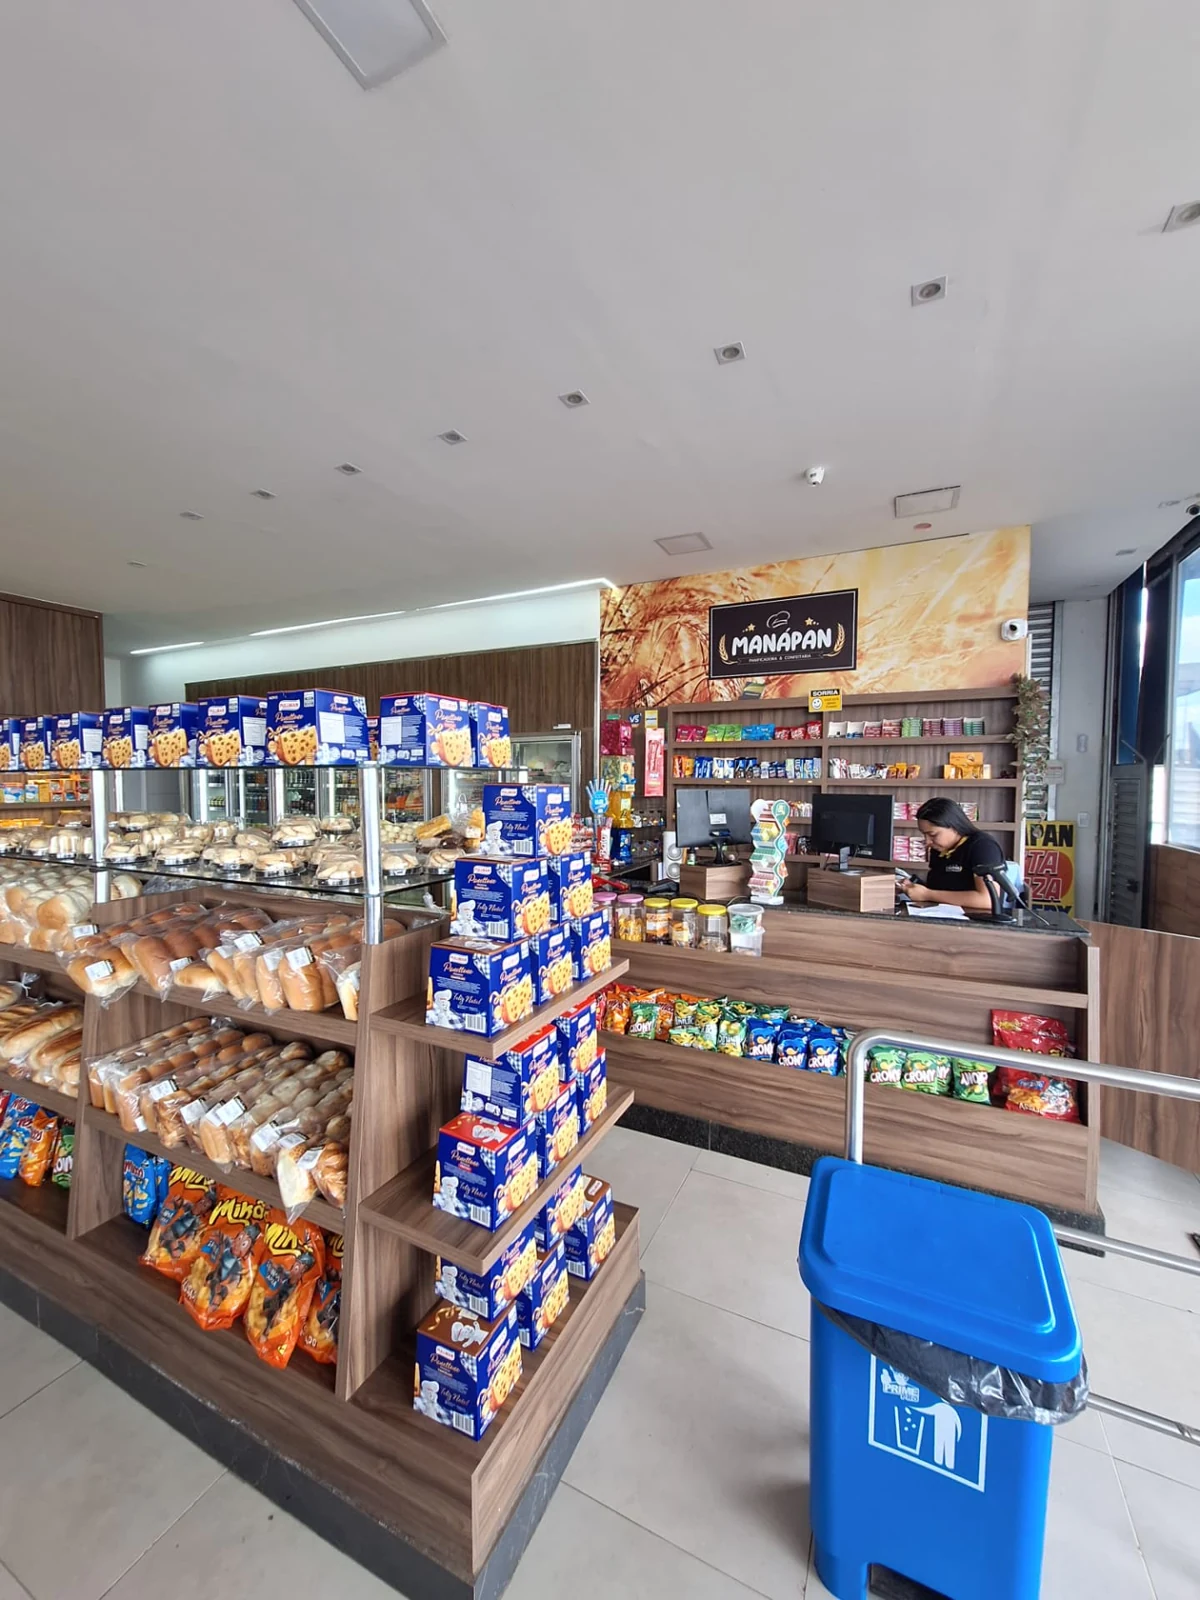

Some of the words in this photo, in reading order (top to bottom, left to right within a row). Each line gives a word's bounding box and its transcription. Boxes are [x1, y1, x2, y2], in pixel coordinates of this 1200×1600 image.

[731, 627, 832, 656] MANÁPAN
[1028, 850, 1060, 875] TA
[904, 1068, 936, 1083] CRONY
[884, 1383, 919, 1396] PRIME
